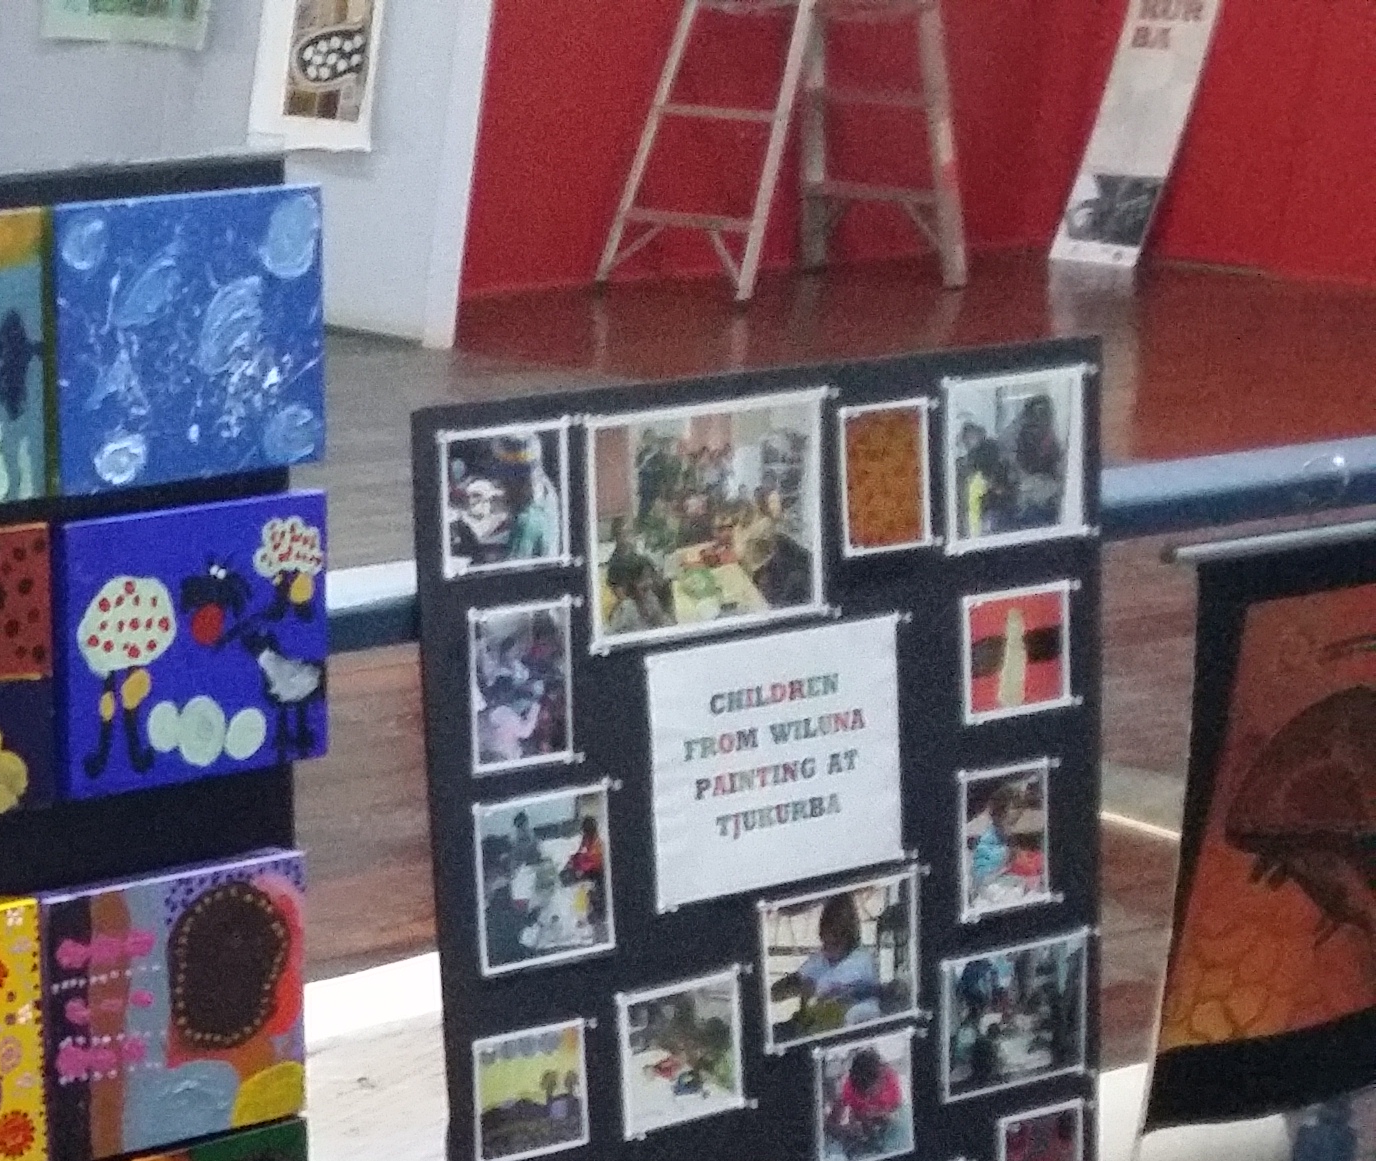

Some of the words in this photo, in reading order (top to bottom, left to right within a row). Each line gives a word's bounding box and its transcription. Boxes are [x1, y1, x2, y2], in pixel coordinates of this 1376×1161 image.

[710, 672, 839, 715] CHILDREN
[683, 727, 759, 762] FROM
[769, 708, 866, 744] WILUNA
[695, 757, 816, 800] PAINTING
[827, 749, 858, 775] AT
[716, 793, 841, 840] TJUKURBA
